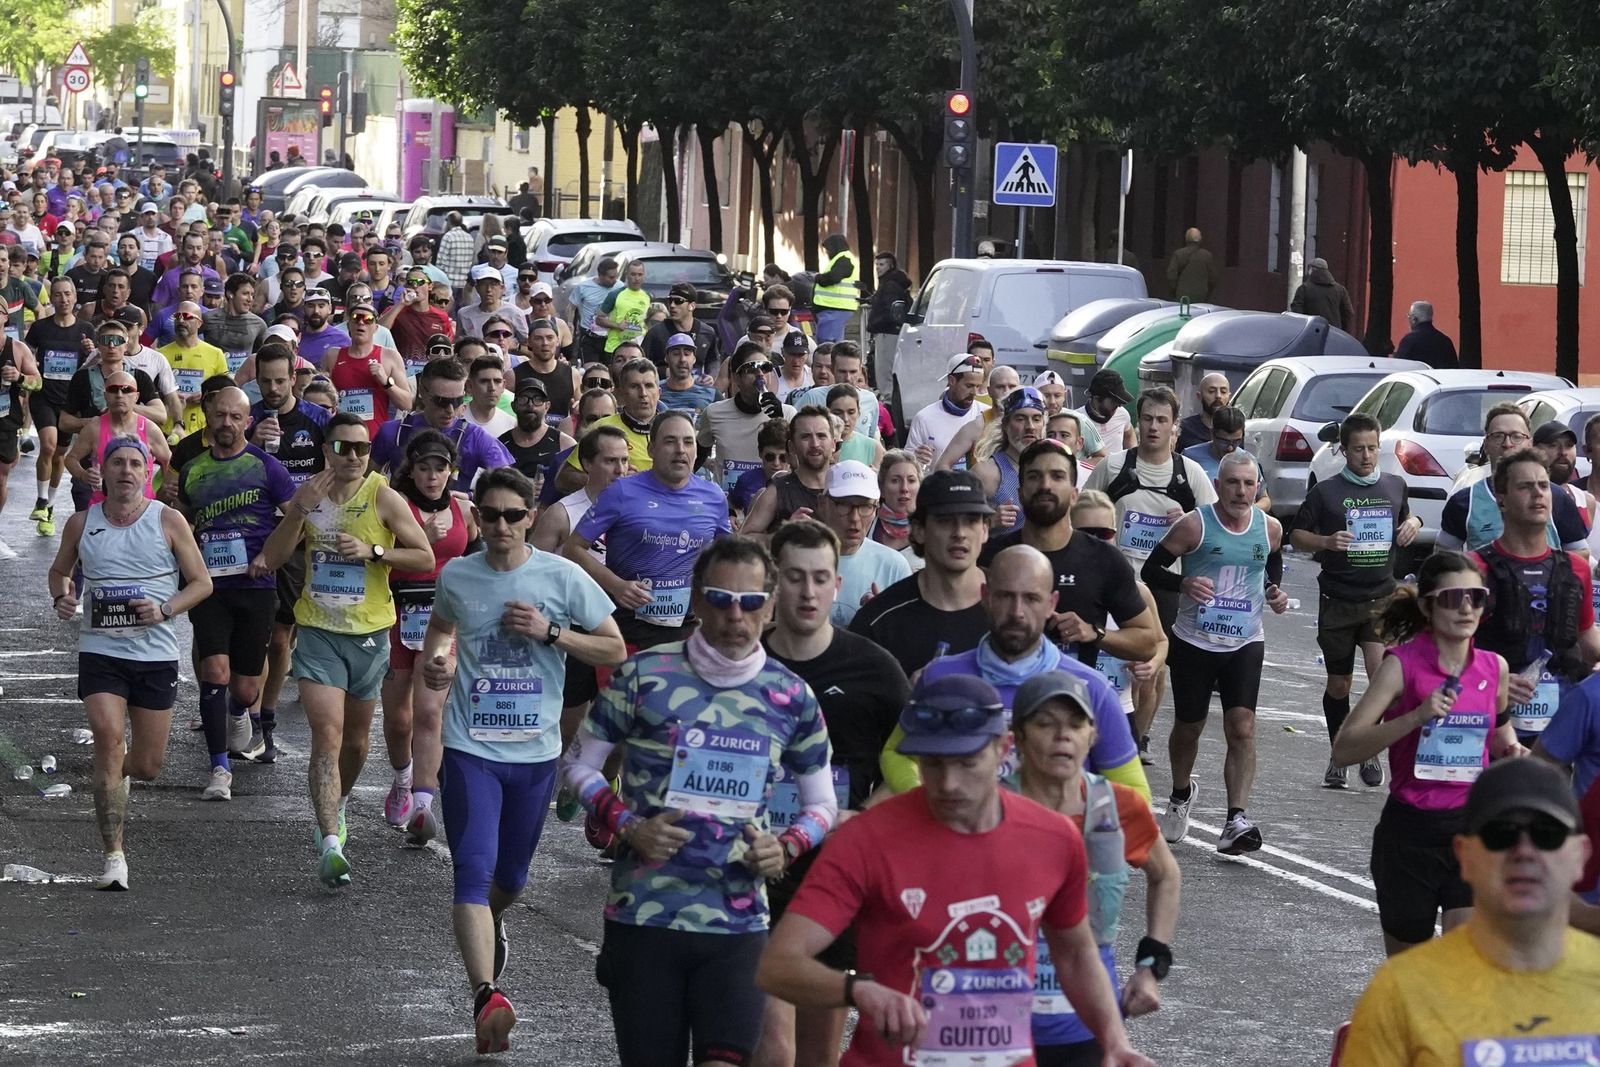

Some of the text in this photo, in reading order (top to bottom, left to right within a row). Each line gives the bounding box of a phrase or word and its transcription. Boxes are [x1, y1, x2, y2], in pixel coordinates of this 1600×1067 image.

[70, 76, 85, 84] 30
[280, 457, 315, 467] RSPORT
[205, 488, 261, 519] MOJAMAS
[1142, 515, 1168, 525] ZURICH
[211, 532, 236, 541] ZURICH
[1356, 531, 1385, 541] JORGE
[208, 555, 236, 567] CHINO
[331, 583, 365, 594] GONZÁLEZ
[655, 579, 685, 588] ZURICH
[106, 588, 138, 598] ZURICH
[108, 604, 126, 612] 5198
[642, 603, 684, 615] JKNUÑO
[1218, 600, 1247, 609] ZURICH
[1202, 621, 1243, 635] PATRICK
[495, 682, 534, 691] ZURICH
[495, 700, 516, 710] 8861
[473, 713, 539, 727] PEDRULEZ
[1448, 715, 1484, 725] ZURICH
[710, 735, 761, 751] ZURICH
[1444, 735, 1463, 744] 6850
[1416, 754, 1444, 764] MARIE
[707, 759, 734, 773] 8186
[683, 770, 750, 797] ÁLVARO
[962, 974, 1023, 990] ZURICH
[939, 1025, 1012, 1047] GUITOU
[1512, 1040, 1594, 1064] ZURICH
